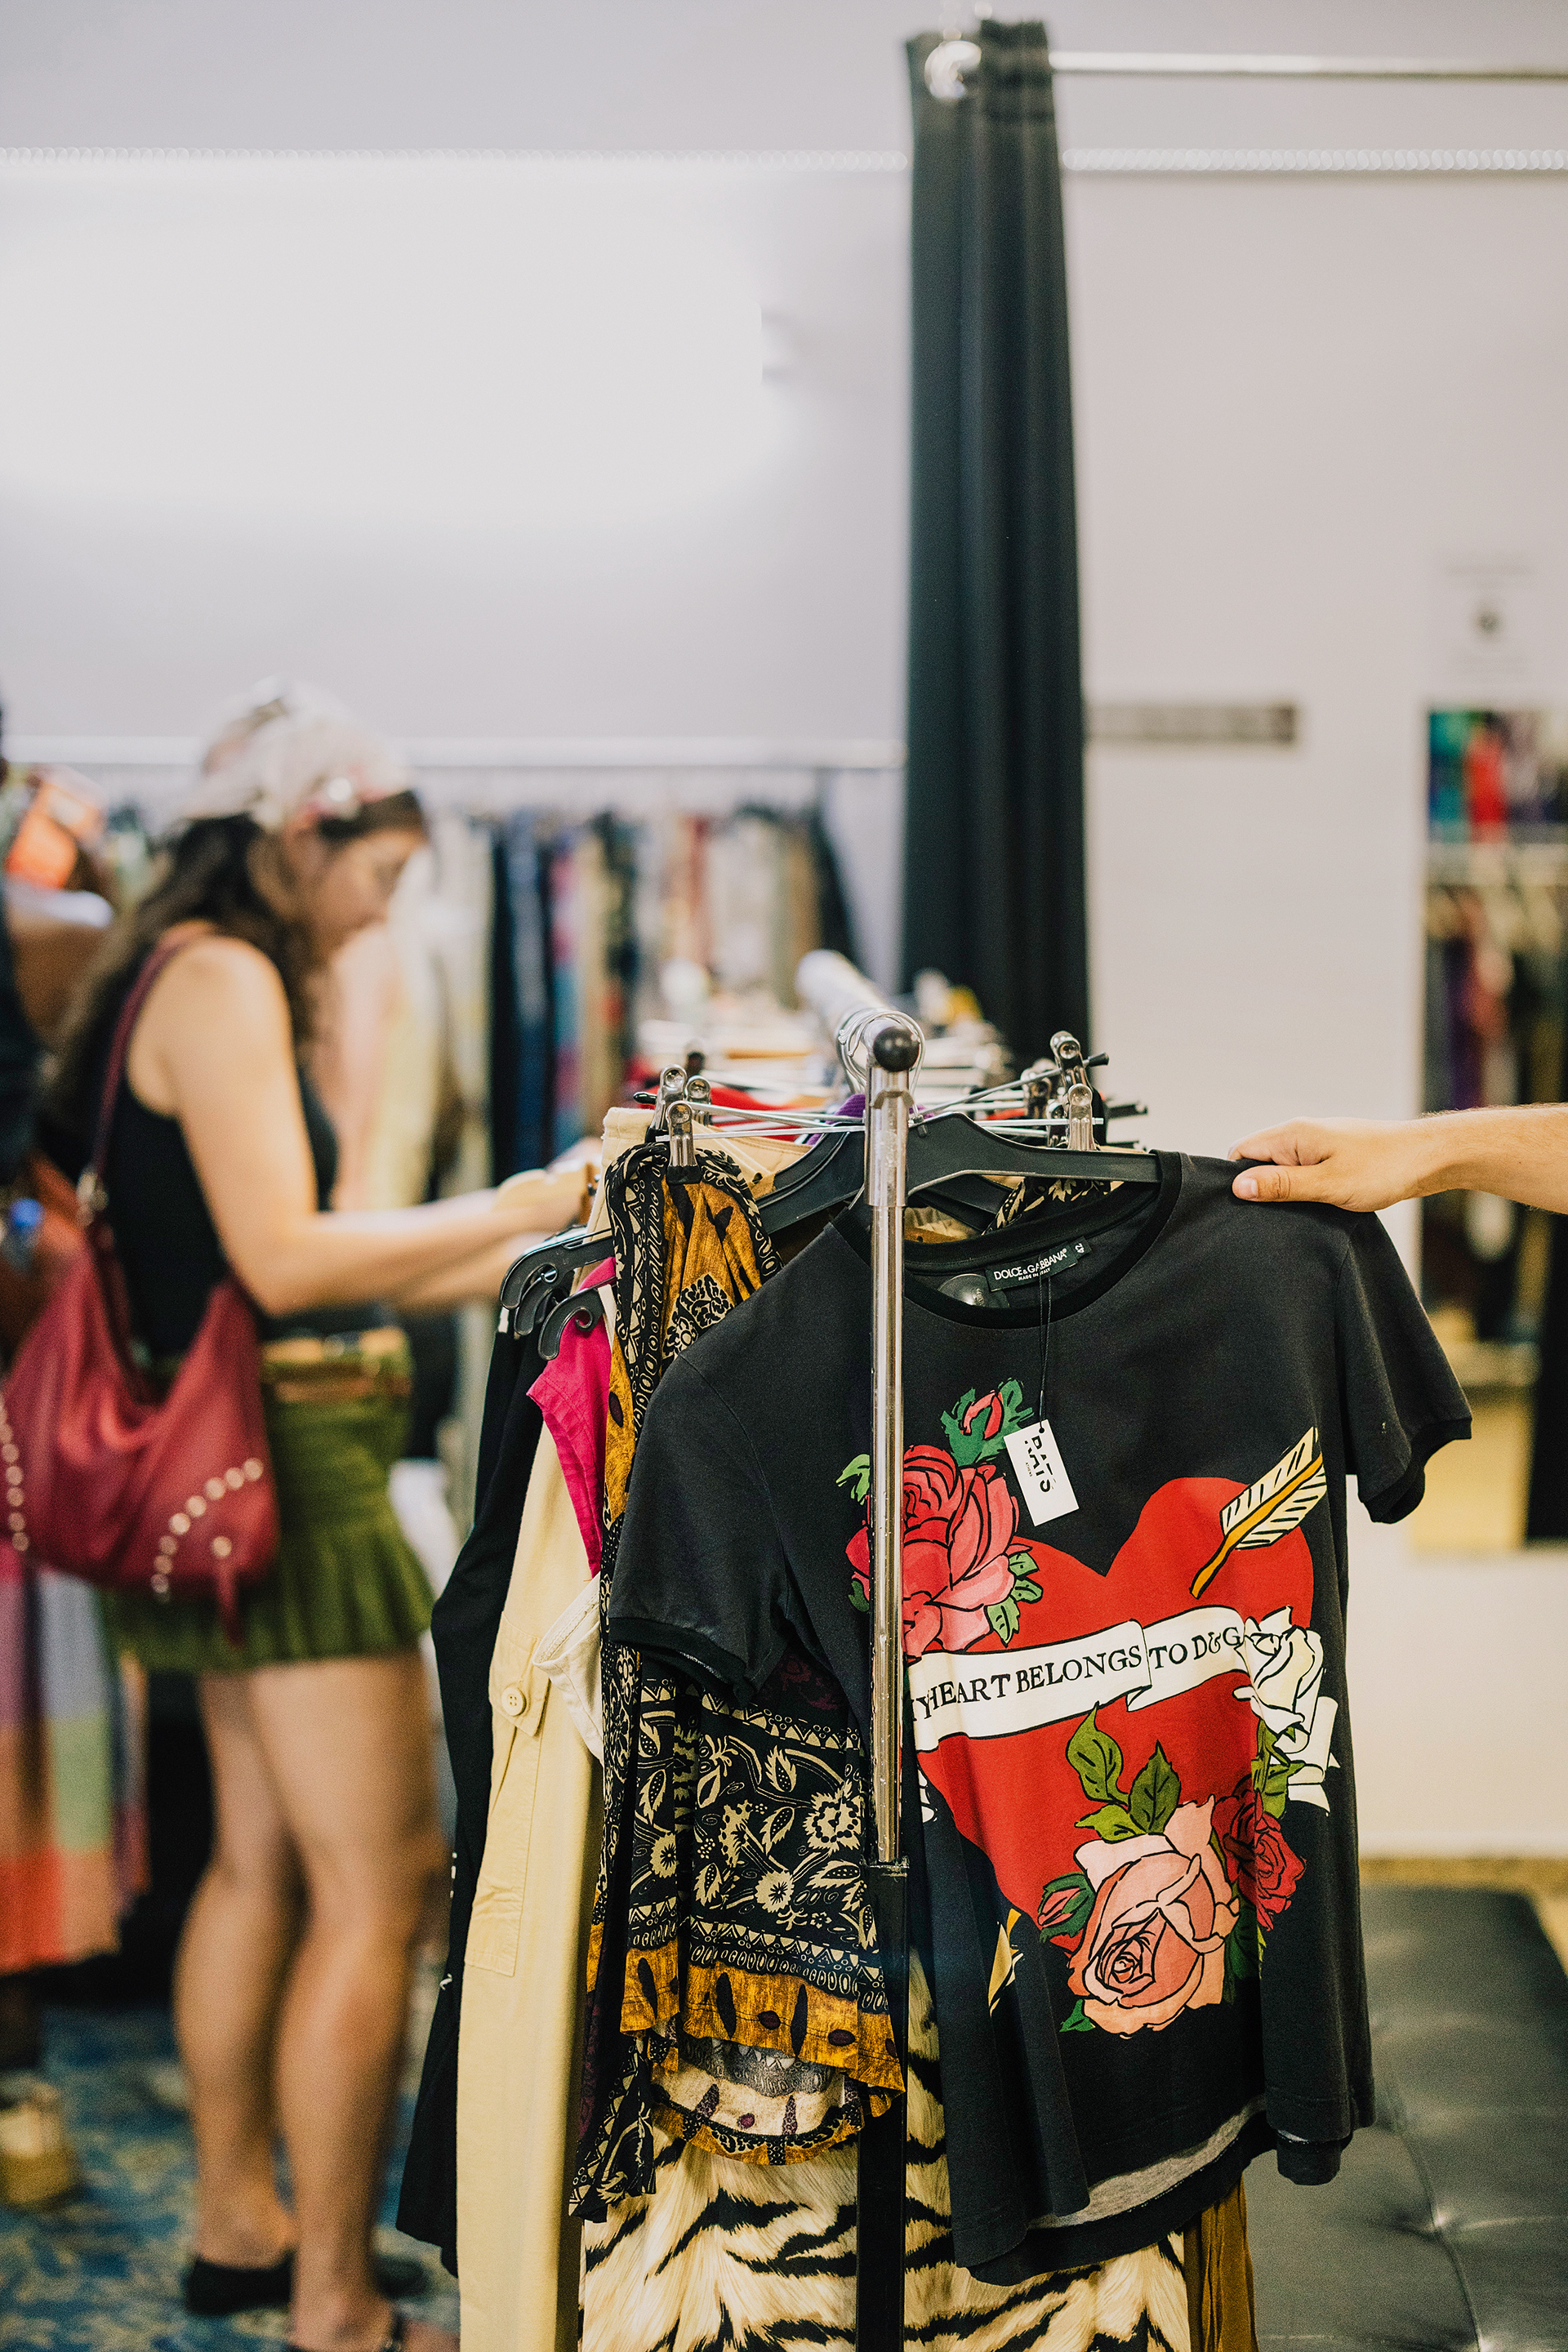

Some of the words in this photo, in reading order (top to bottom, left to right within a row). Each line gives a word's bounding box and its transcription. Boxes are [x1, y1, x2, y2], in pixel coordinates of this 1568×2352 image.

[1075, 1243, 1085, 1253] 42
[1024, 1435, 1057, 1493] RATS
[928, 1673, 1011, 1710] HEART
[1015, 1645, 1143, 1694] BELONGS
[1148, 1642, 1188, 1669] TO
[1191, 1627, 1242, 1660] D&G
